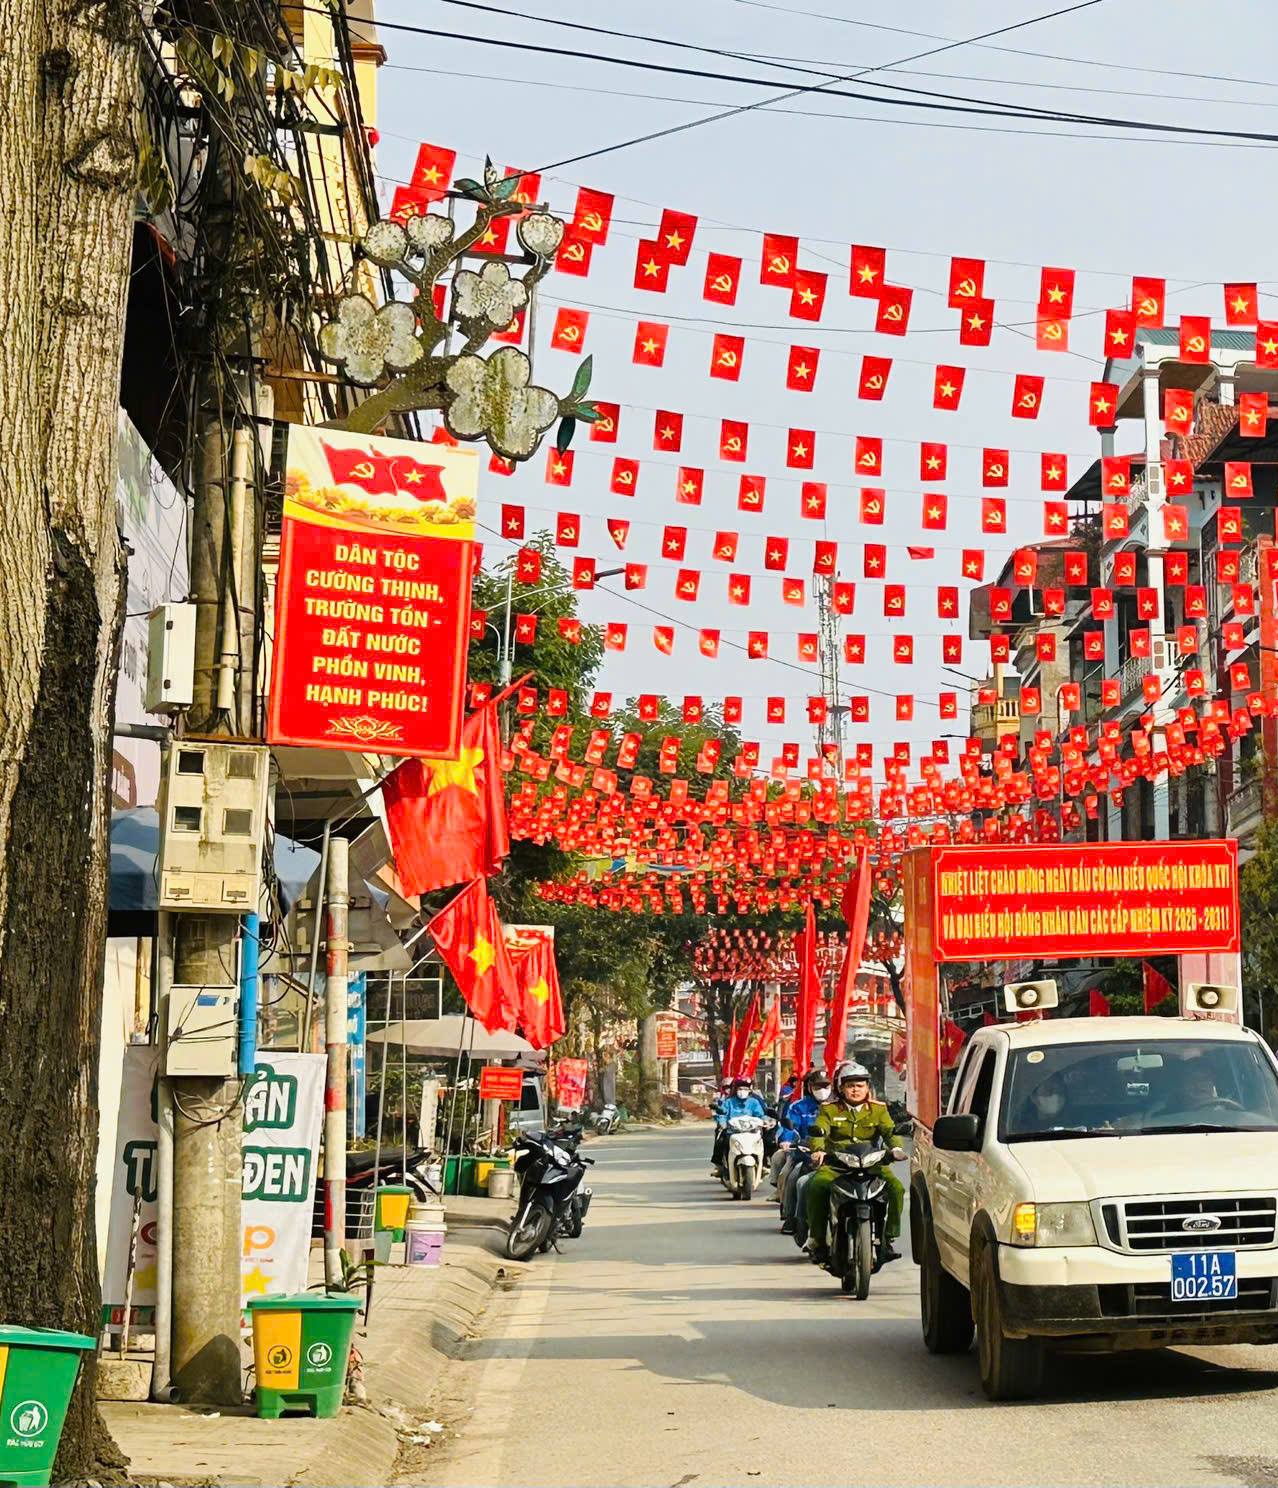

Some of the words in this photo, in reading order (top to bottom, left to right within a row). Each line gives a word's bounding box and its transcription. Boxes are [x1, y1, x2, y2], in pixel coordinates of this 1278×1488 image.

[336, 544, 377, 565] DÂN
[383, 549, 420, 573] TỘC
[306, 569, 375, 593] CƯỜNG
[381, 578, 443, 603] THỊNH,
[304, 598, 384, 623] TRƯỜNG
[322, 626, 361, 648] ĐẤT
[366, 633, 421, 655] NƯỚC
[374, 663, 426, 686] VINH,
[306, 684, 362, 707] HẠNH
[368, 691, 428, 712] PHÚC!
[942, 865, 968, 901] NHIỆT
[970, 865, 989, 901] LIỆT
[991, 864, 1016, 895] CHÀO
[1017, 863, 1044, 895] MỪNG
[1046, 863, 1070, 893] NGÀY
[1072, 858, 1091, 892] BẦU
[1092, 859, 1105, 891] CỬ
[1106, 866, 1122, 896] ĐẠI
[1124, 856, 1144, 891] BIỂU
[1146, 856, 1170, 893] QUỐC
[1172, 859, 1188, 895] HỘI
[1214, 864, 1230, 888] XVI
[943, 908, 955, 940] VÀ
[957, 913, 973, 944] ĐẠI
[975, 902, 996, 938] BIỂU
[998, 907, 1014, 944] HỘI
[1015, 904, 1041, 936] ĐỒNG
[1042, 905, 1069, 936] NHÂN
[1070, 905, 1089, 935] DÂN
[1090, 904, 1109, 935] CÁC
[1111, 900, 1129, 934] CẤP
[1130, 902, 1160, 939] NHIỆM
[1161, 901, 1173, 933] KỲ
[1189, 1254, 1221, 1276] 11A
[1174, 1275, 1234, 1298] 002.57
